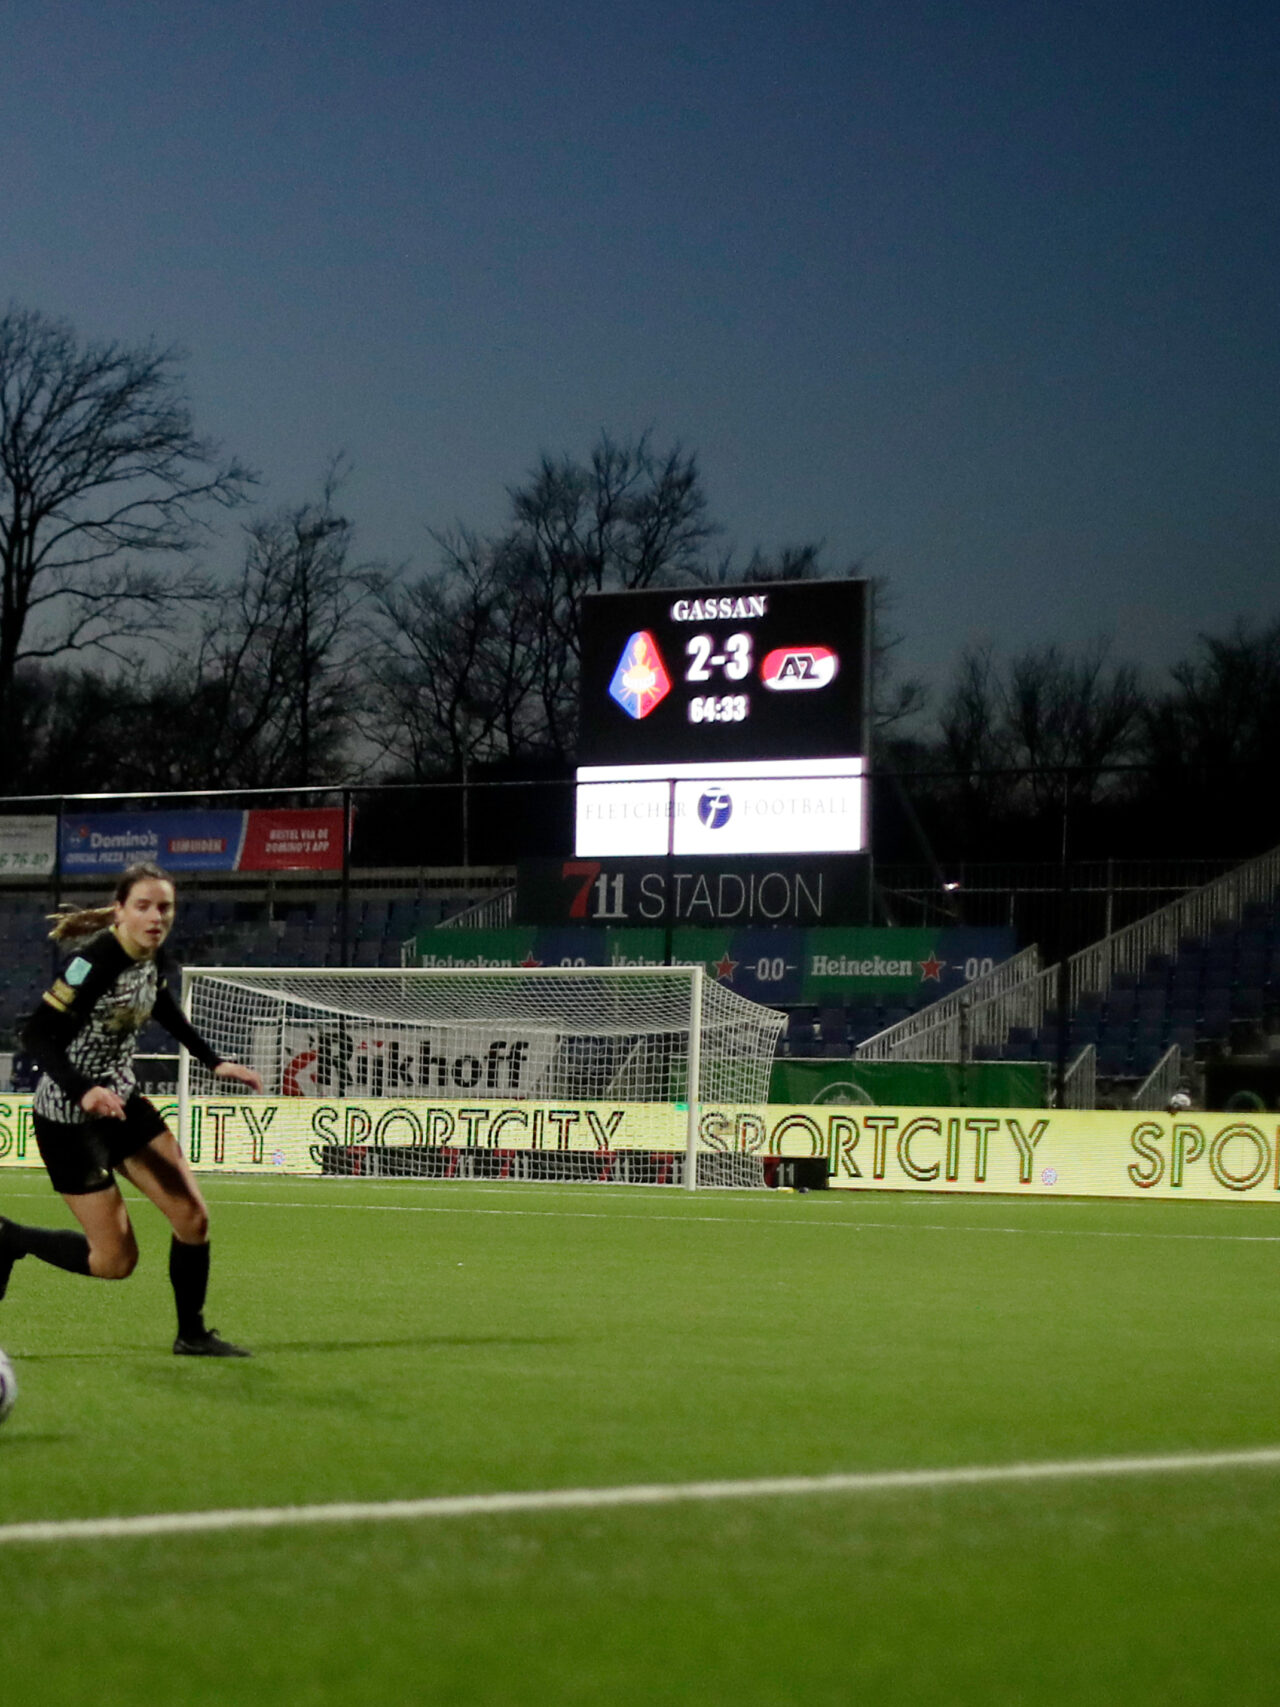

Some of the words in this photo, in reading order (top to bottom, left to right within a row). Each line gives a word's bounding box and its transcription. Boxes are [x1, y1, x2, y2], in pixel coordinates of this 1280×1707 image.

[672, 596, 766, 621] GASSAN
[685, 633, 752, 682] 2-3
[776, 653, 820, 682] AZ
[689, 696, 747, 723] 64:33
[582, 800, 687, 820] FLETCHER
[743, 796, 848, 816] FOOTBALL
[90, 829, 158, 849] Domino's
[638, 872, 823, 918] STADION
[811, 954, 913, 977] Heineken
[310, 1105, 625, 1164] SPORTCITY
[700, 1112, 1049, 1185] SPORTCITY
[1127, 1120, 1280, 1192] SPO
